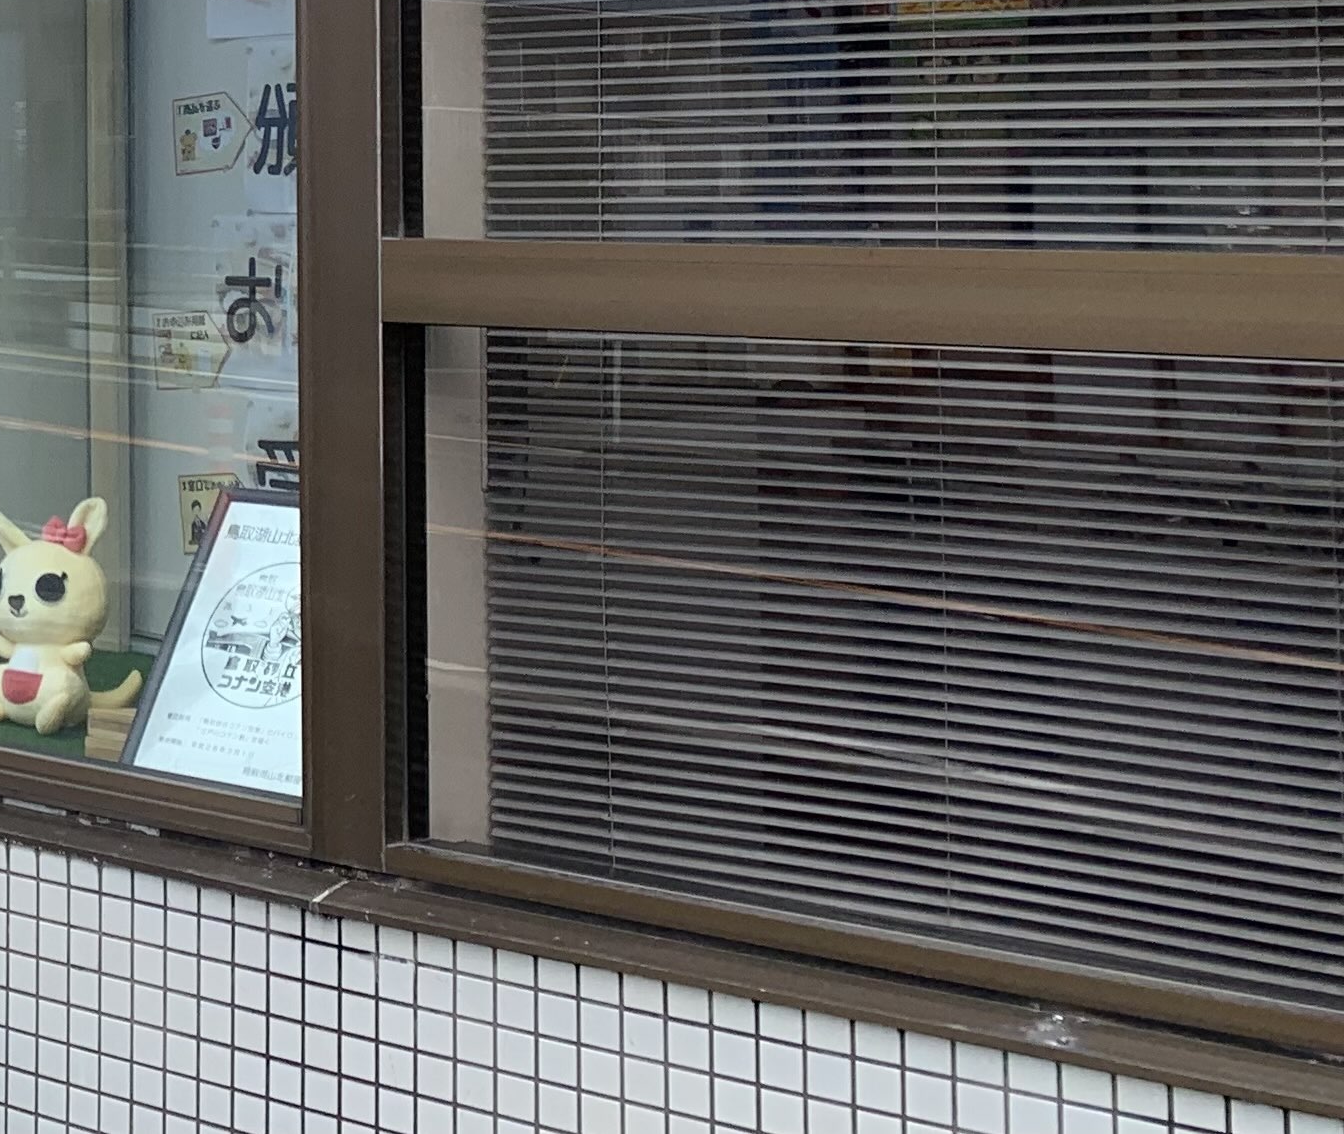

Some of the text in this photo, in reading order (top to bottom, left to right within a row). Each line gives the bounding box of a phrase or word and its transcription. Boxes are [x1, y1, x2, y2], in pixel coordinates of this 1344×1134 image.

[225, 257, 283, 343] お
[225, 524, 300, 547] 鳥取湖山北
